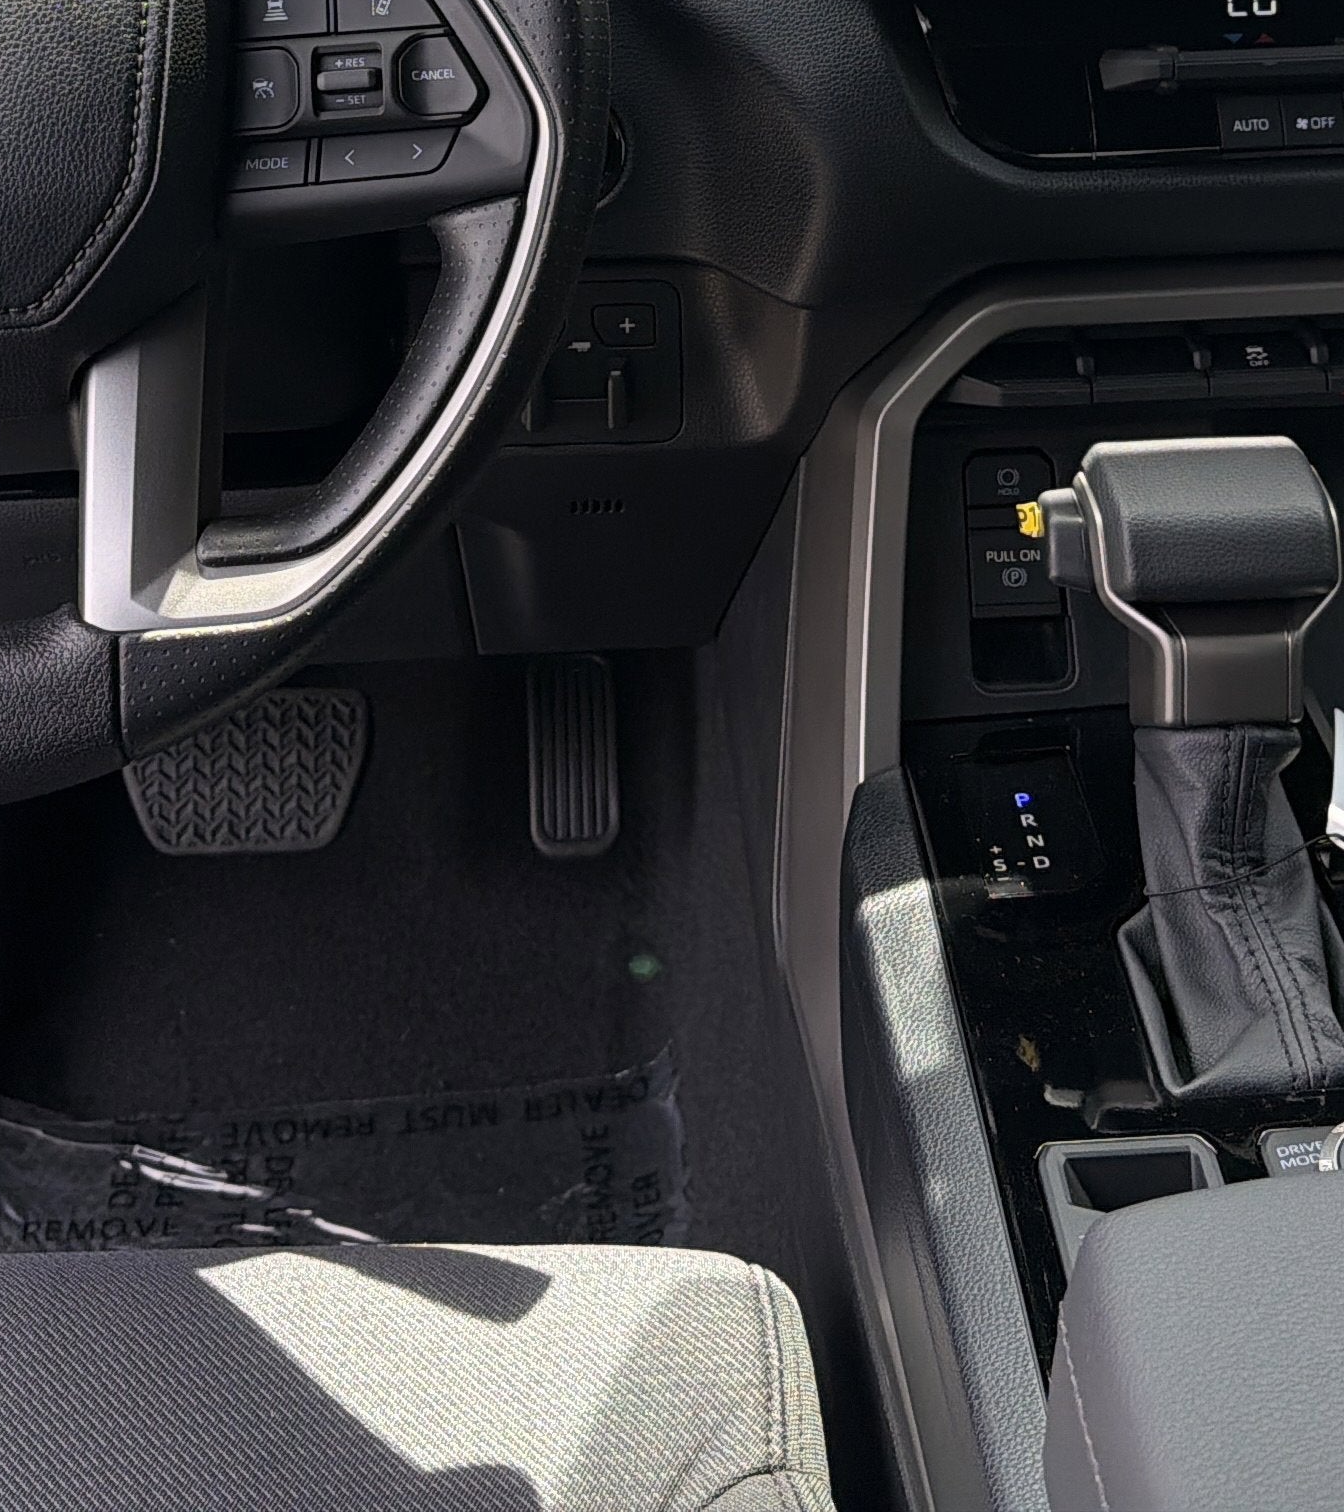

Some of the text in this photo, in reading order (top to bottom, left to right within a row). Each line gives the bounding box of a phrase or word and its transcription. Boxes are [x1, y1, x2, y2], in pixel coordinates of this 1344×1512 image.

[411, 70, 456, 81] CANCEL
[1233, 118, 1270, 132] AUTO
[1310, 116, 1336, 129] OFF
[246, 157, 289, 170] MODE
[986, 549, 1041, 563] PULL ON
[1015, 792, 1031, 808] P
[1020, 813, 1038, 827] R
[1026, 834, 1045, 848] N
[993, 855, 1051, 872] S D
[1280, 1153, 1321, 1170] MOD
[22, 1212, 182, 1244] REMOVE
